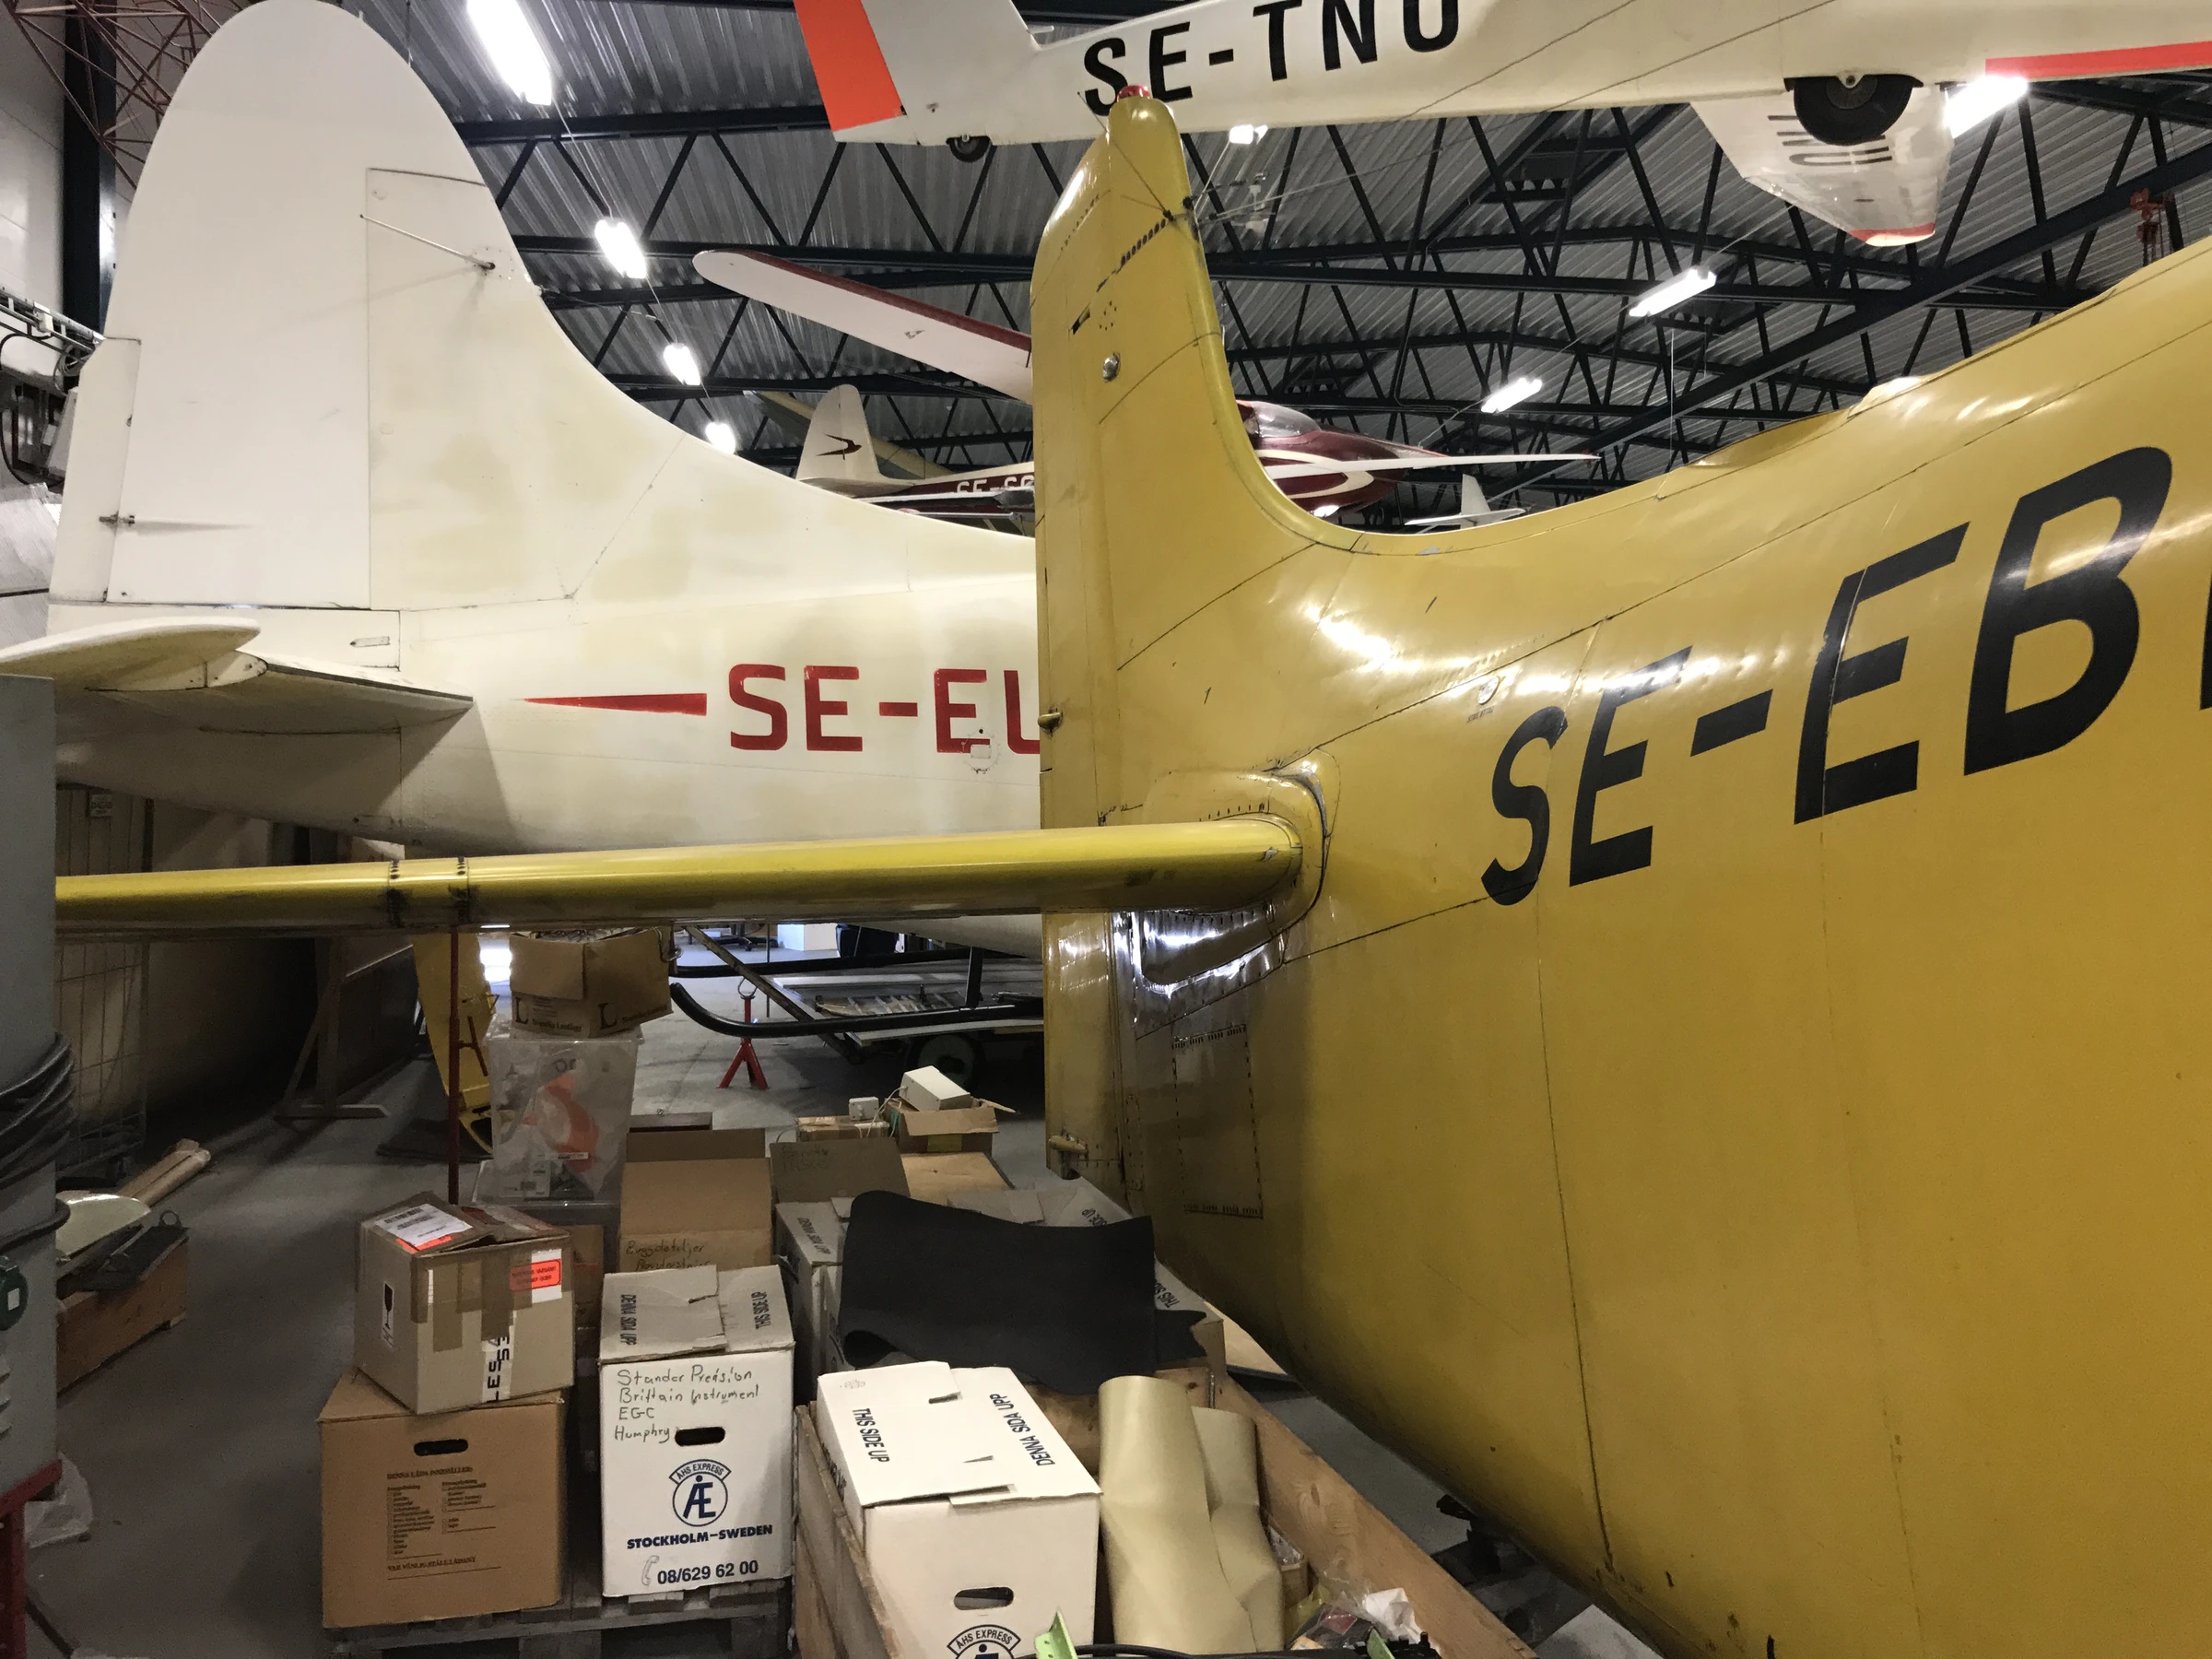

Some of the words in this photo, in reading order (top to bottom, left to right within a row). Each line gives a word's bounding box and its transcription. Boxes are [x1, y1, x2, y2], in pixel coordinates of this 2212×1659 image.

[1480, 446, 2212, 906] SE-EB
[989, 1393, 1015, 1411] UPP
[853, 1408, 877, 1427] THIS
[1003, 1412, 1031, 1433] SIDA
[859, 1428, 885, 1448] SIDE
[867, 1450, 890, 1463] UP
[1019, 1435, 1056, 1466] DENNA
[692, 1463, 725, 1476] EXPRESS
[657, 1566, 712, 1584] 08/629
[715, 1562, 735, 1578] 62
[739, 1559, 759, 1574] 00
[975, 1629, 1013, 1645] EXPRESS
